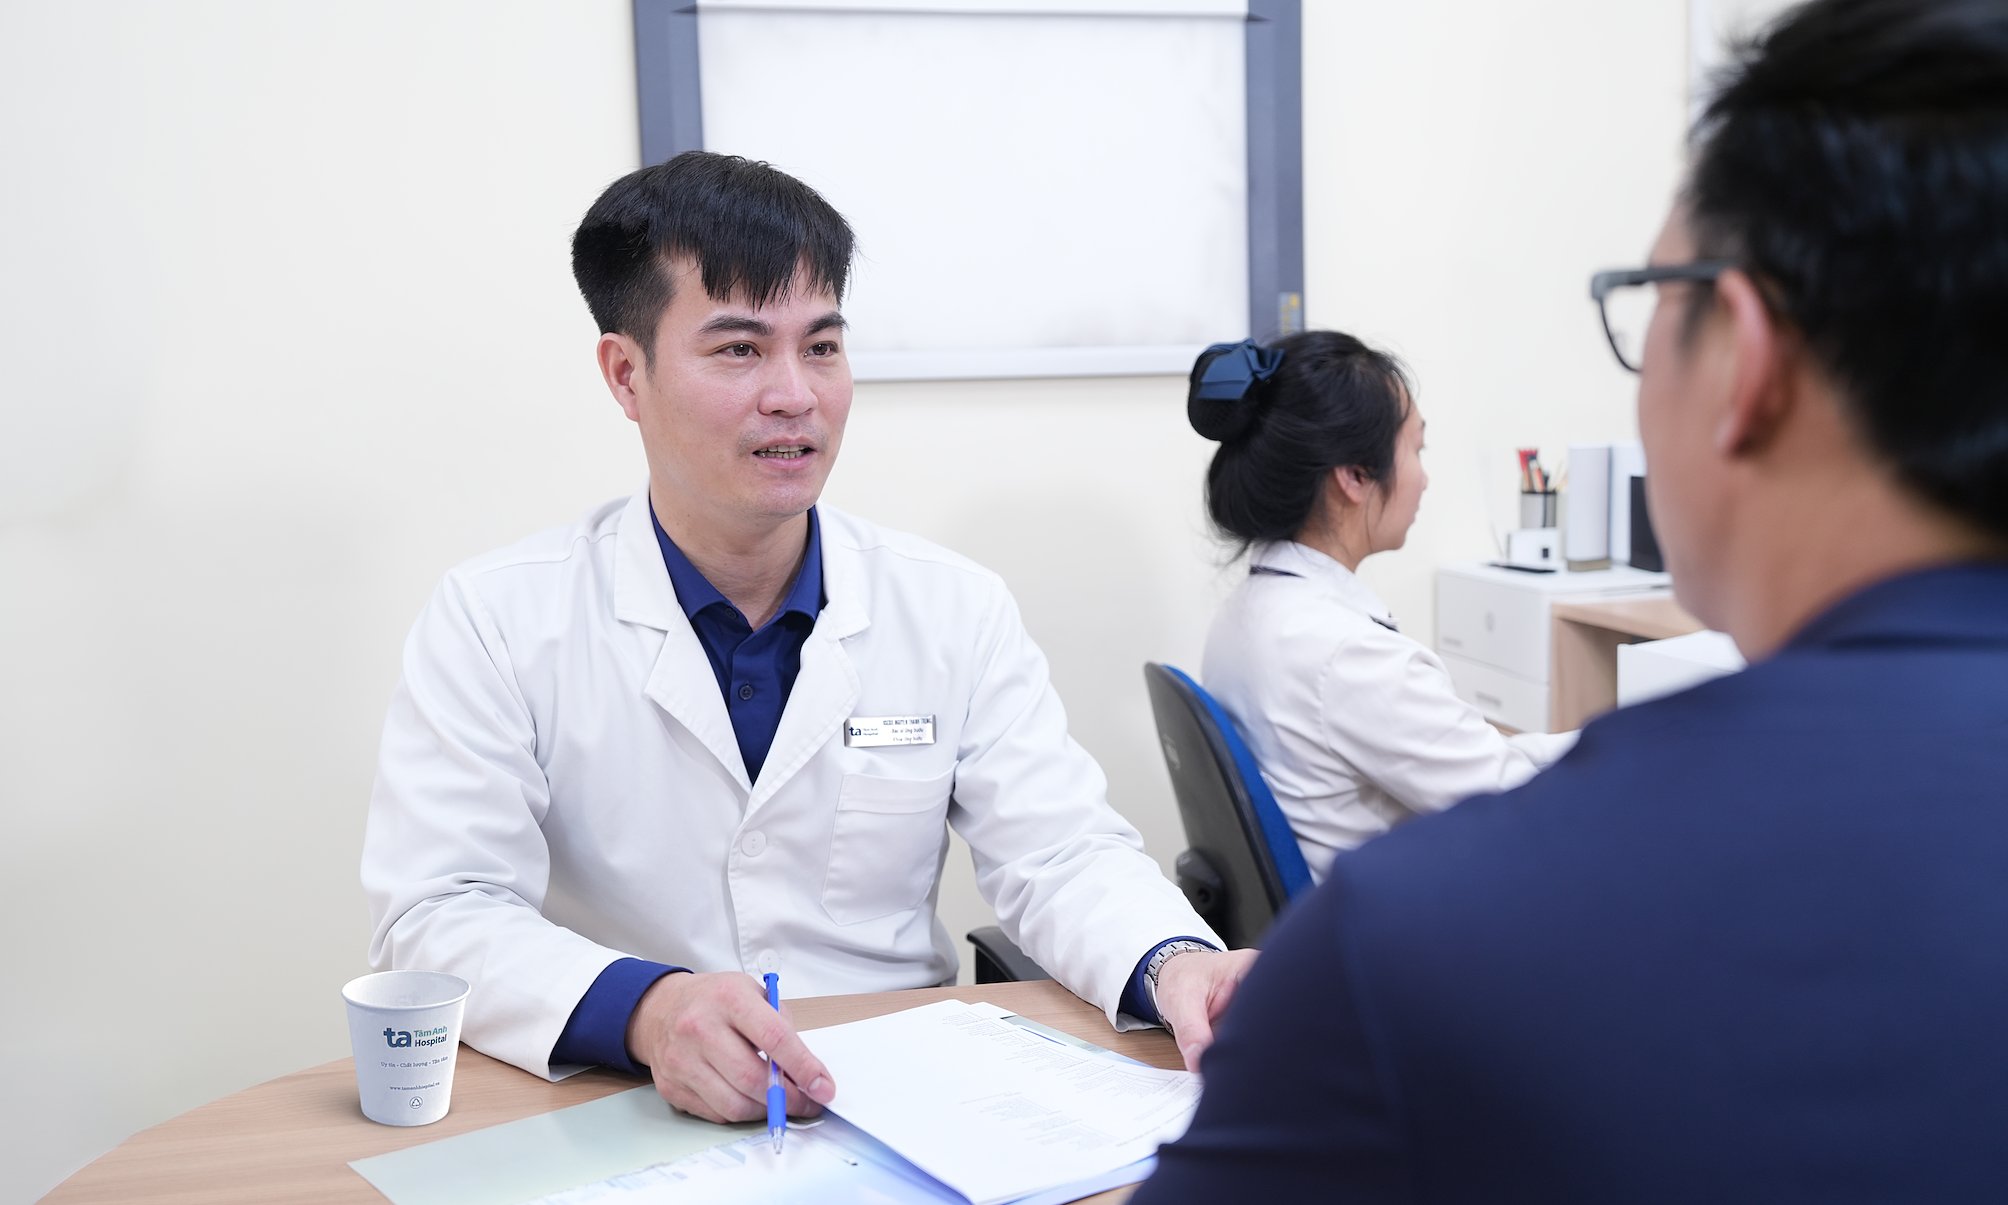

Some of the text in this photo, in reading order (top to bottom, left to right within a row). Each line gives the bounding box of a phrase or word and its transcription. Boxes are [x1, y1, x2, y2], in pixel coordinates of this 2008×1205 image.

[849, 727, 861, 736] ta
[383, 1027, 412, 1048] ta
[414, 1026, 448, 1038] Tâm Anh
[415, 1034, 447, 1047] Hospital
